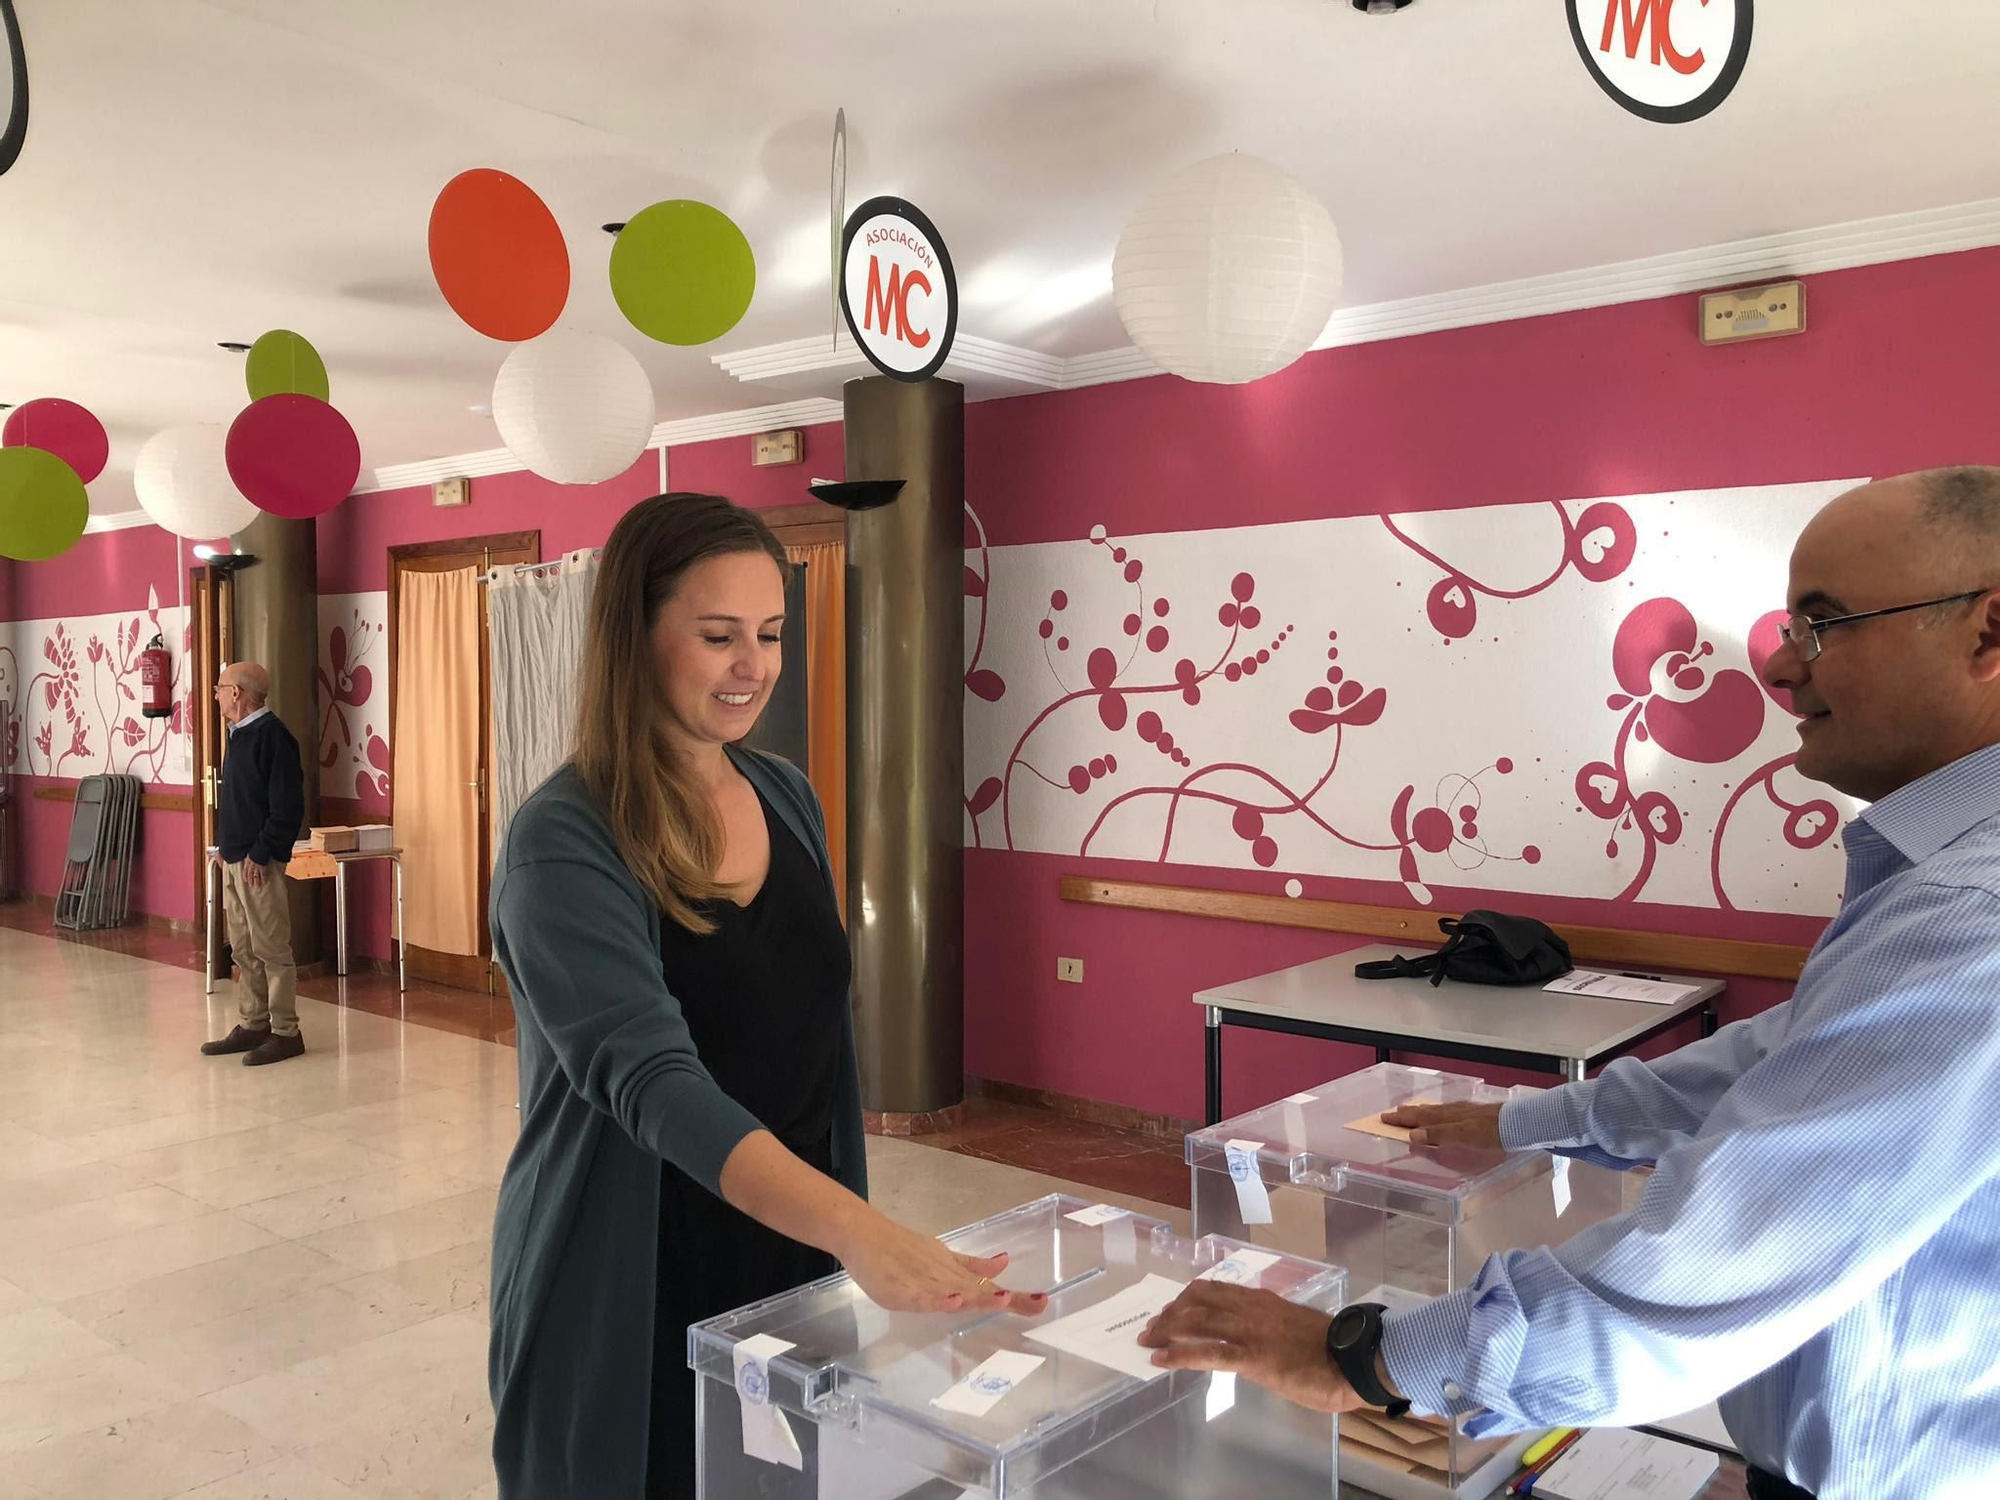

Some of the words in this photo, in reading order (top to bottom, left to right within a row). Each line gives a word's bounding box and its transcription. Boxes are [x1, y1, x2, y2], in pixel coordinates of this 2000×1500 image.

[1599, 0, 1709, 75] MC
[866, 228, 933, 269] ASOCIACIÓN
[863, 254, 932, 349] MC
